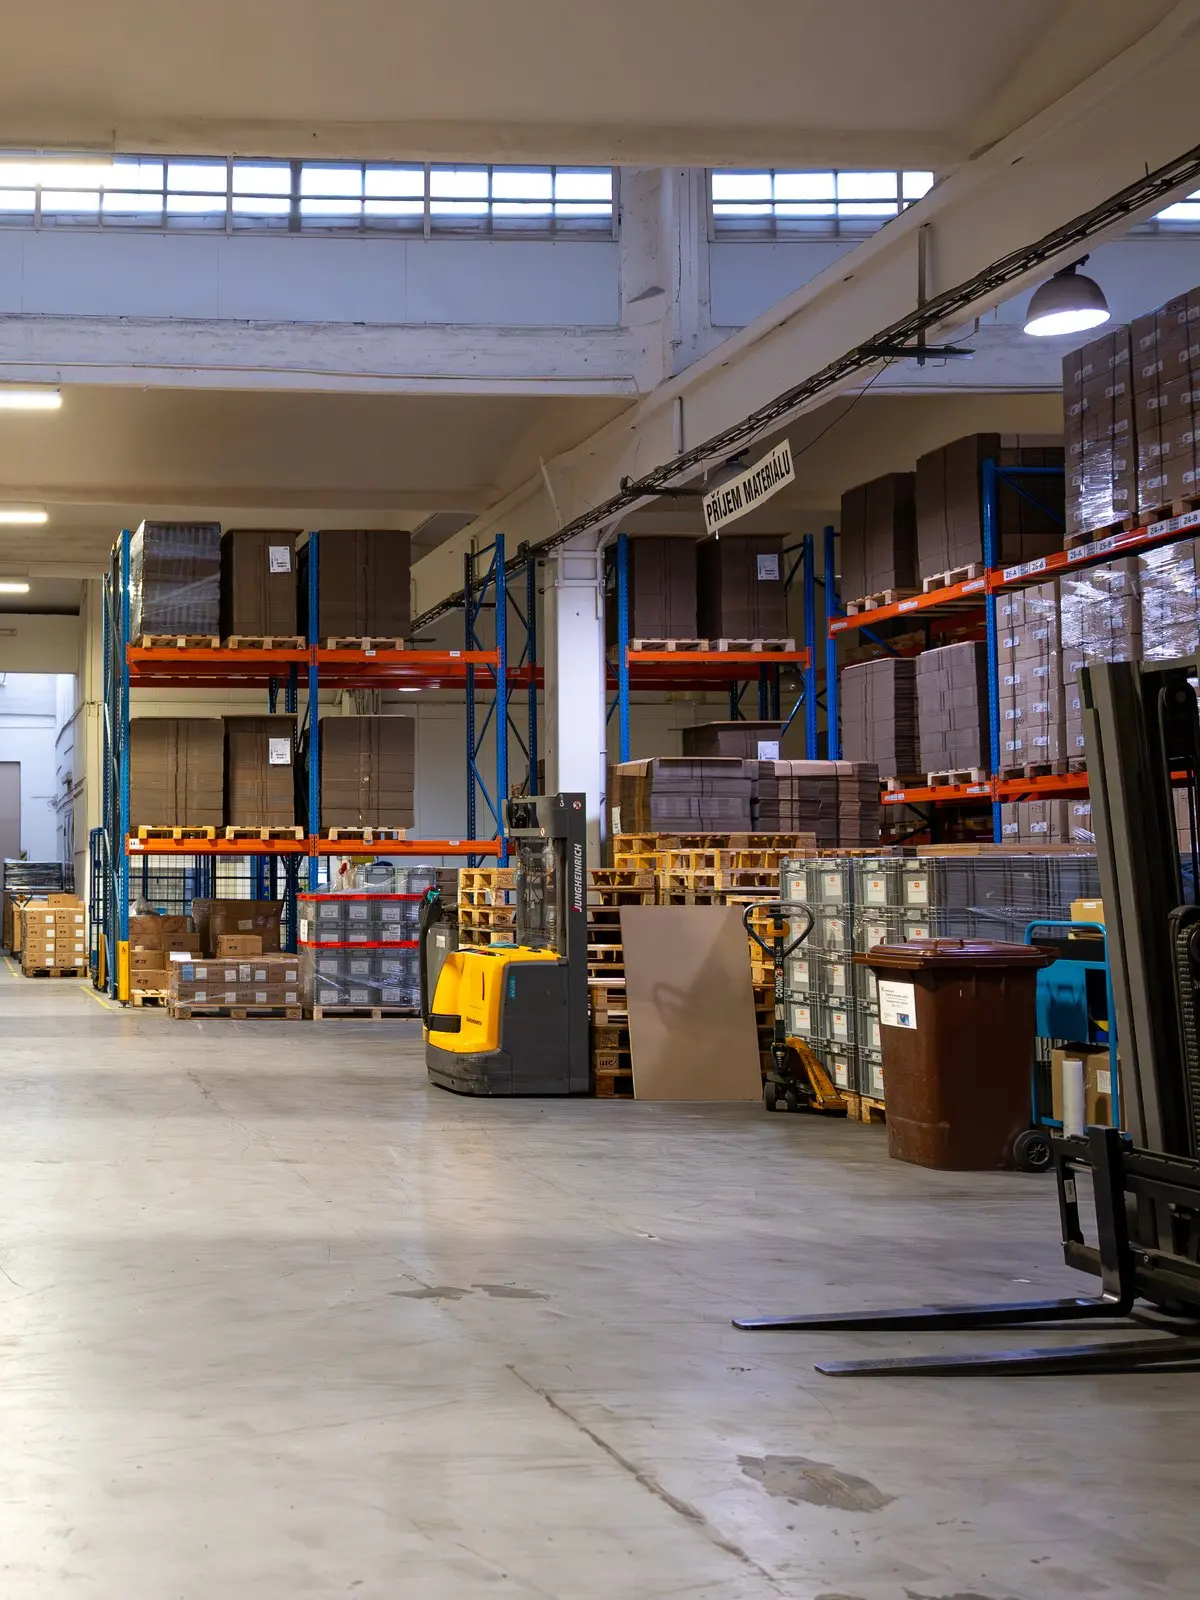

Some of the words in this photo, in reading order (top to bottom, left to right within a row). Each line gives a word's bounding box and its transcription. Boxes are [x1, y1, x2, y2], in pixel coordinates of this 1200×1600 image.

[706, 490, 743, 526] PŘÍJEM
[742, 449, 791, 504] MATERIÁLU
[572, 843, 583, 912] JUNGHEINRICH
